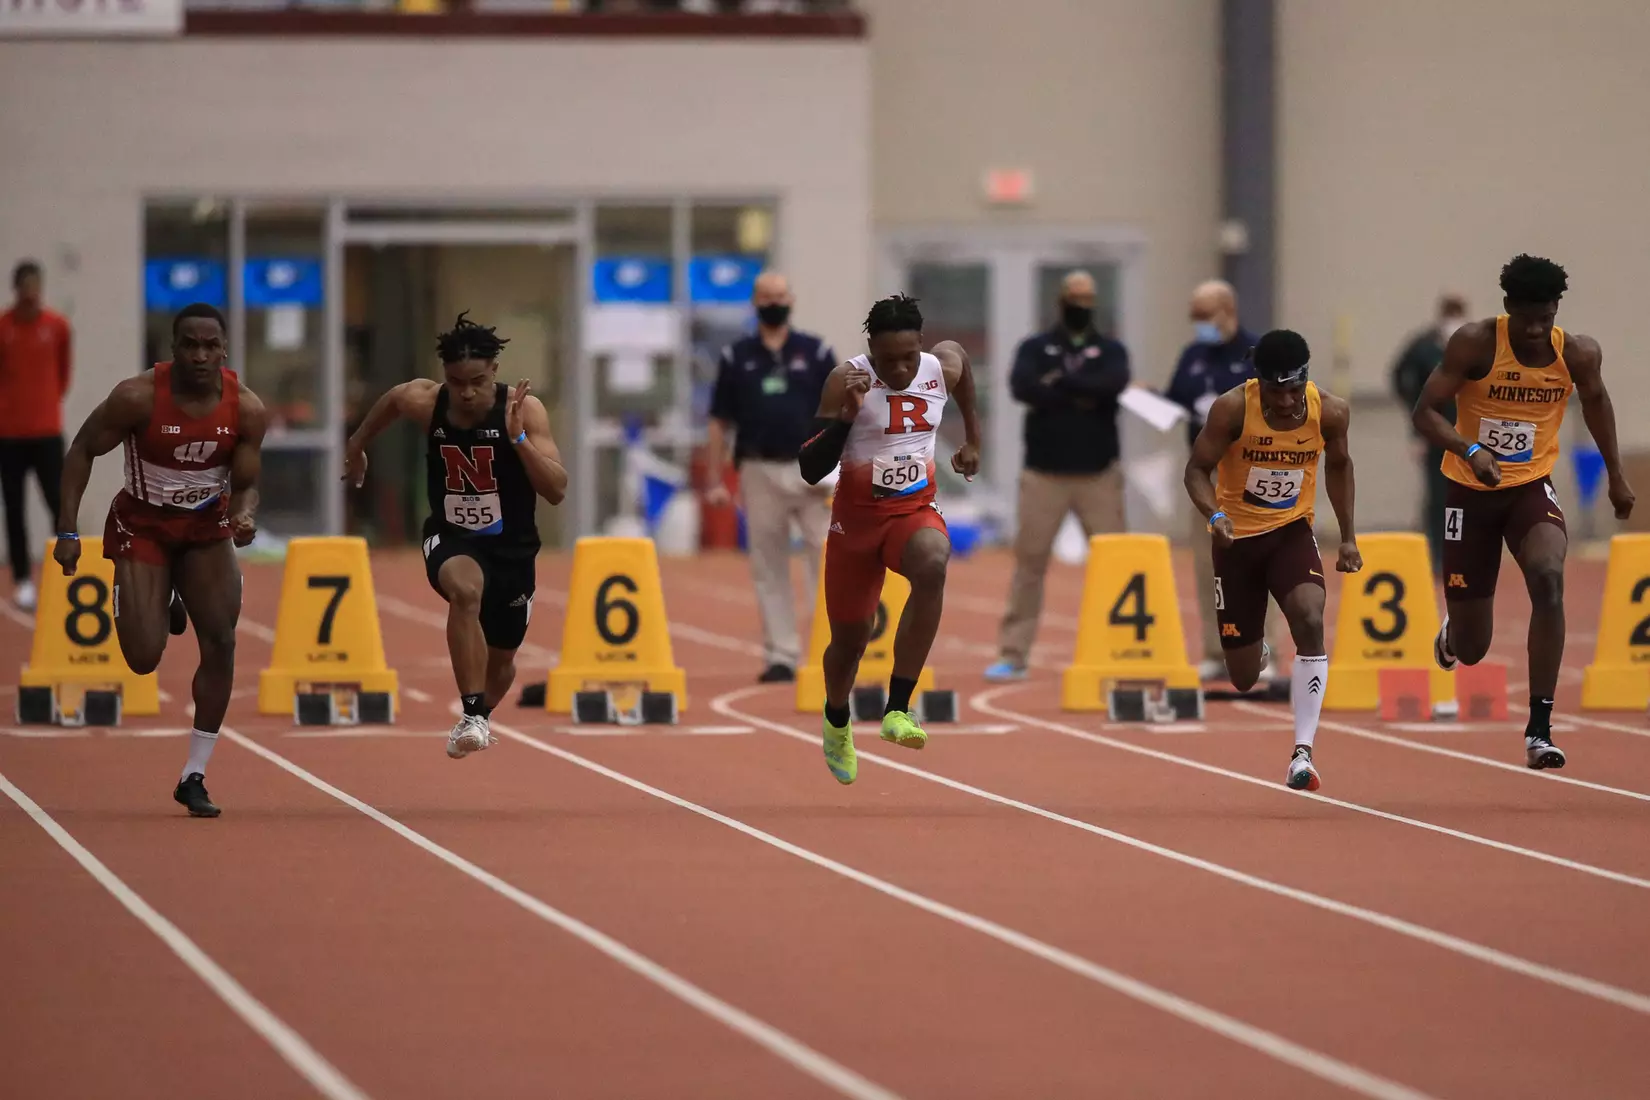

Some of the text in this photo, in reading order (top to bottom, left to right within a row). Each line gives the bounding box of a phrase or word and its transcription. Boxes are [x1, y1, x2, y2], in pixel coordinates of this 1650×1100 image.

[884, 394, 935, 435] R
[1487, 429, 1528, 451] 528
[439, 444, 498, 492] N
[881, 464, 919, 486] 650
[1254, 479, 1295, 498] 532
[172, 487, 211, 504] 668
[454, 506, 494, 525] 555
[1447, 510, 1458, 538] 4
[65, 576, 111, 646] 8
[307, 576, 350, 645] 7
[595, 575, 639, 645] 6
[1109, 573, 1155, 641] 4
[1361, 572, 1407, 642] 3
